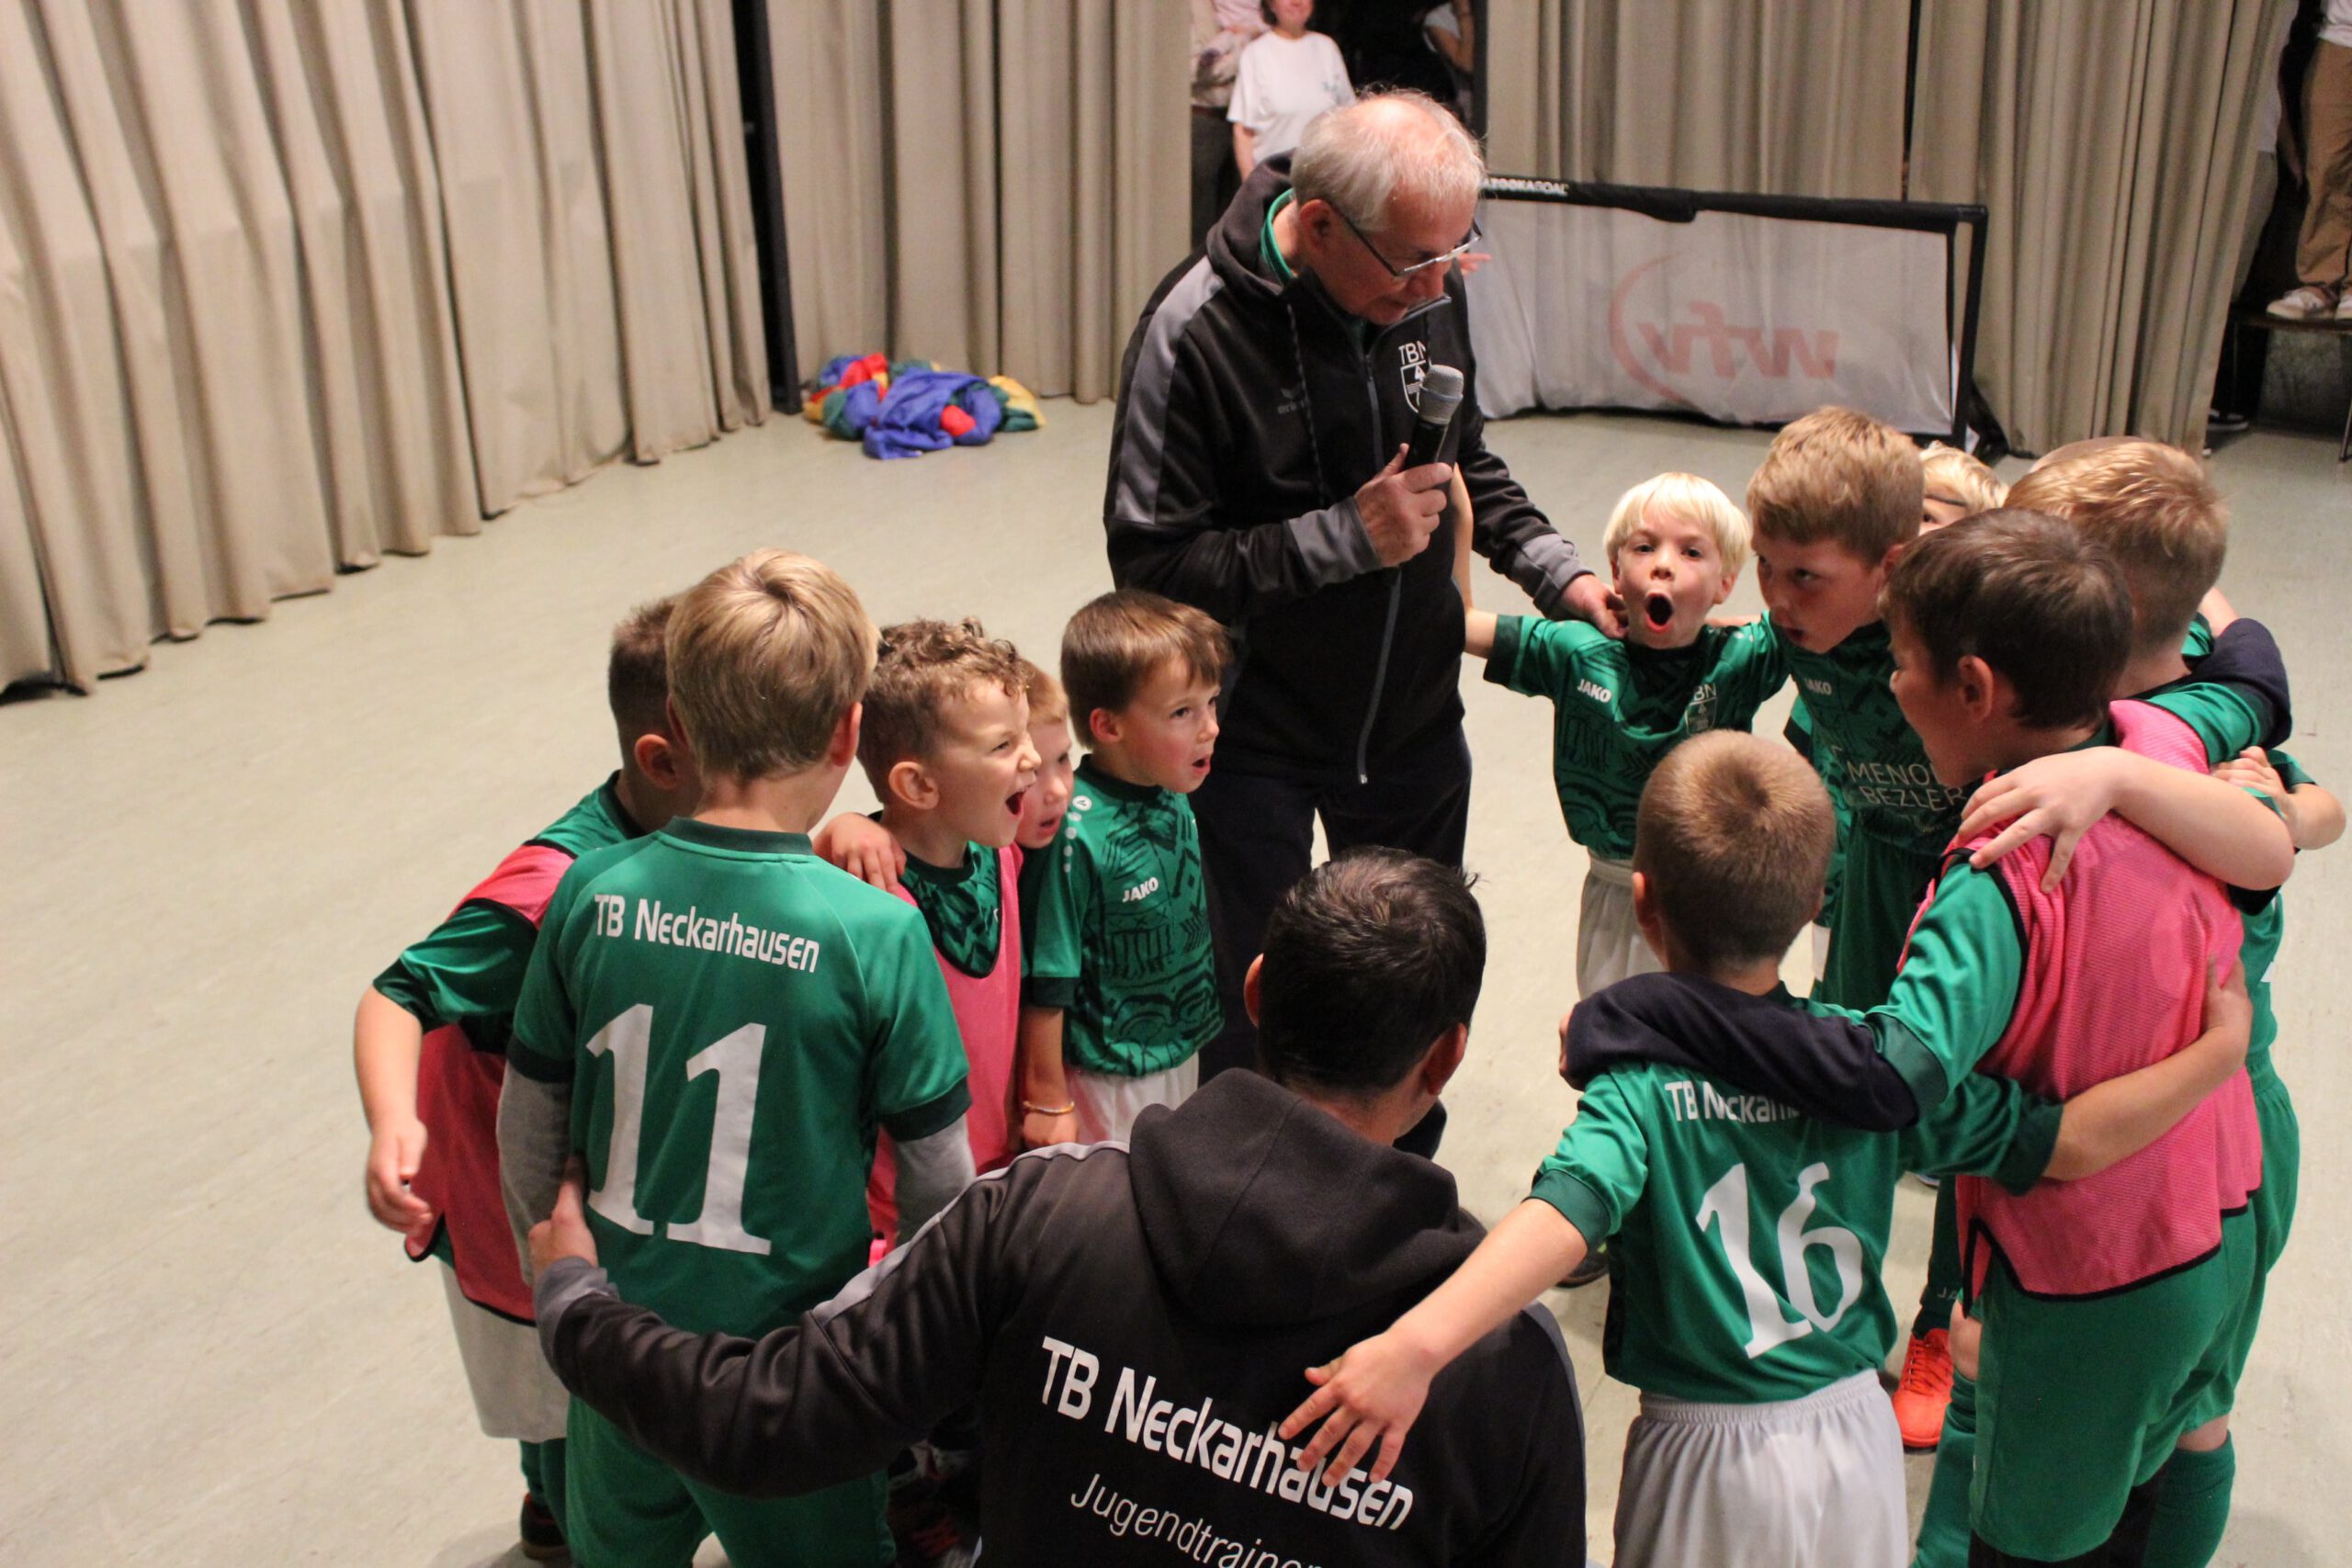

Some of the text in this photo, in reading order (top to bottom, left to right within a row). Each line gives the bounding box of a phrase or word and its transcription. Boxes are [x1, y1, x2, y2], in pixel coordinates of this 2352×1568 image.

[1577, 679, 1612, 703] JAKO
[1859, 784, 1967, 812] BEZLER
[1122, 876, 1159, 903] JAKO
[594, 894, 820, 974] TB Neckarhausen
[585, 1003, 772, 1256] 11
[1665, 1080, 1699, 1122] TB
[1695, 1161, 1863, 1359] 16
[1041, 1336, 1414, 1531] TB Neckarhausen
